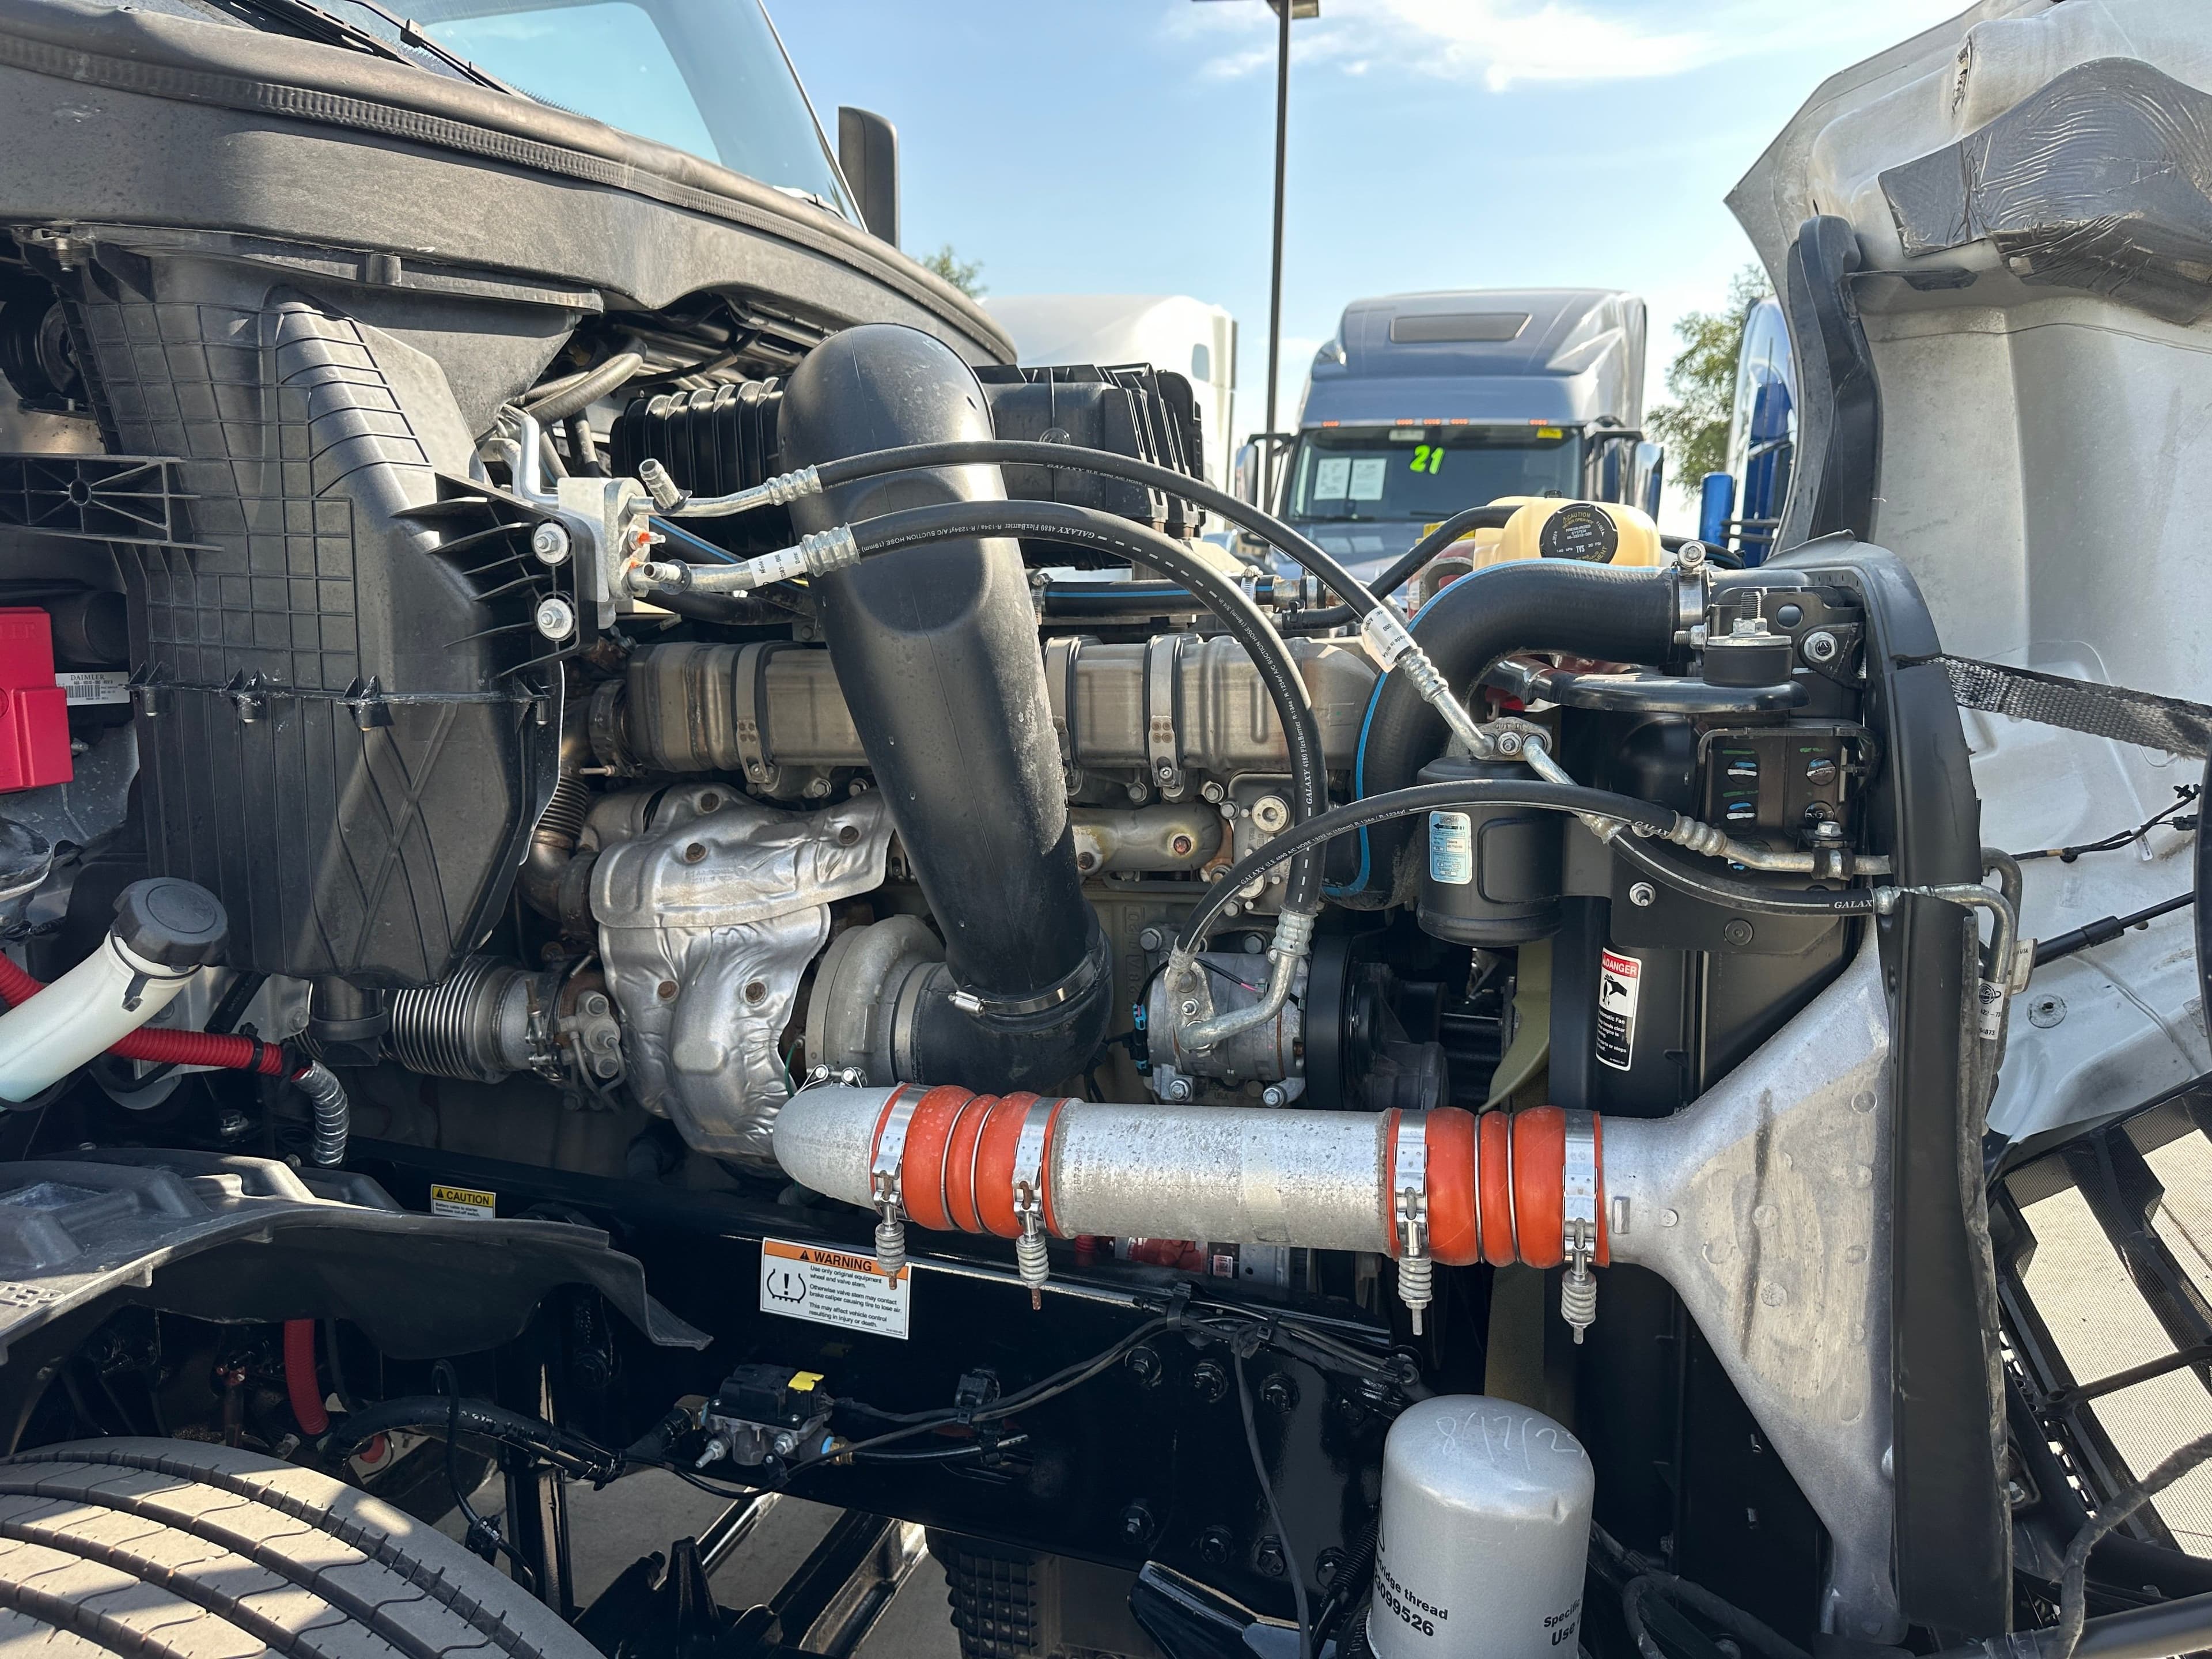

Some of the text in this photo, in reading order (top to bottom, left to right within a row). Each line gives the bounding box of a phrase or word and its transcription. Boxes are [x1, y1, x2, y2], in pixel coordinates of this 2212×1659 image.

[1047, 464, 1084, 472] GALAXY
[1410, 445, 1444, 474] 21
[906, 531, 935, 540] SUCTION
[949, 525, 976, 535] R-1234yf
[1005, 523, 1040, 531] FlexBarrier
[1057, 527, 1095, 539] GALAXY
[862, 540, 885, 553] (19mm)
[886, 537, 904, 546] HOSE
[1576, 545, 1585, 553] TVS
[1230, 609, 1247, 627] (19mm)
[1244, 626, 1258, 642] HOSE
[1255, 641, 1273, 665] SUCTION
[1270, 665, 1279, 674] A/C
[1289, 700, 1298, 719] R-134a
[1296, 721, 1307, 753] FlexBarrier
[1304, 769, 1313, 804] GALAXY
[1240, 865, 1266, 885] GALAXY
[1266, 859, 1277, 868] SLE
[1297, 840, 1313, 850] HOSE
[1333, 824, 1354, 834] (10mm)
[1354, 817, 1375, 826] R-134a
[1378, 809, 1406, 819] R-1234yf
[1606, 958, 1637, 975] DANGER
[446, 1191, 489, 1205] CAUTION
[814, 1251, 872, 1272] WARNING
[810, 1266, 882, 1284] Use only original equipment
[810, 1273, 825, 1281] wheel
[837, 1278, 851, 1286] valve
[809, 1291, 824, 1299] brake
[825, 1294, 842, 1303] caliper
[843, 1298, 864, 1308] causing
[810, 1284, 835, 1293] Otherwise
[837, 1289, 851, 1297] valve
[865, 1294, 877, 1302] may
[877, 1297, 897, 1305] contact
[809, 1309, 831, 1320] resulting
[839, 1315, 854, 1324] injury
[861, 1319, 877, 1328] death.
[821, 1305, 832, 1313] may
[833, 1306, 849, 1315] affect
[849, 1309, 868, 1318] vehicle
[868, 1313, 887, 1322] control
[1404, 1588, 1448, 1620] thread
[1551, 1622, 1575, 1646] Use
